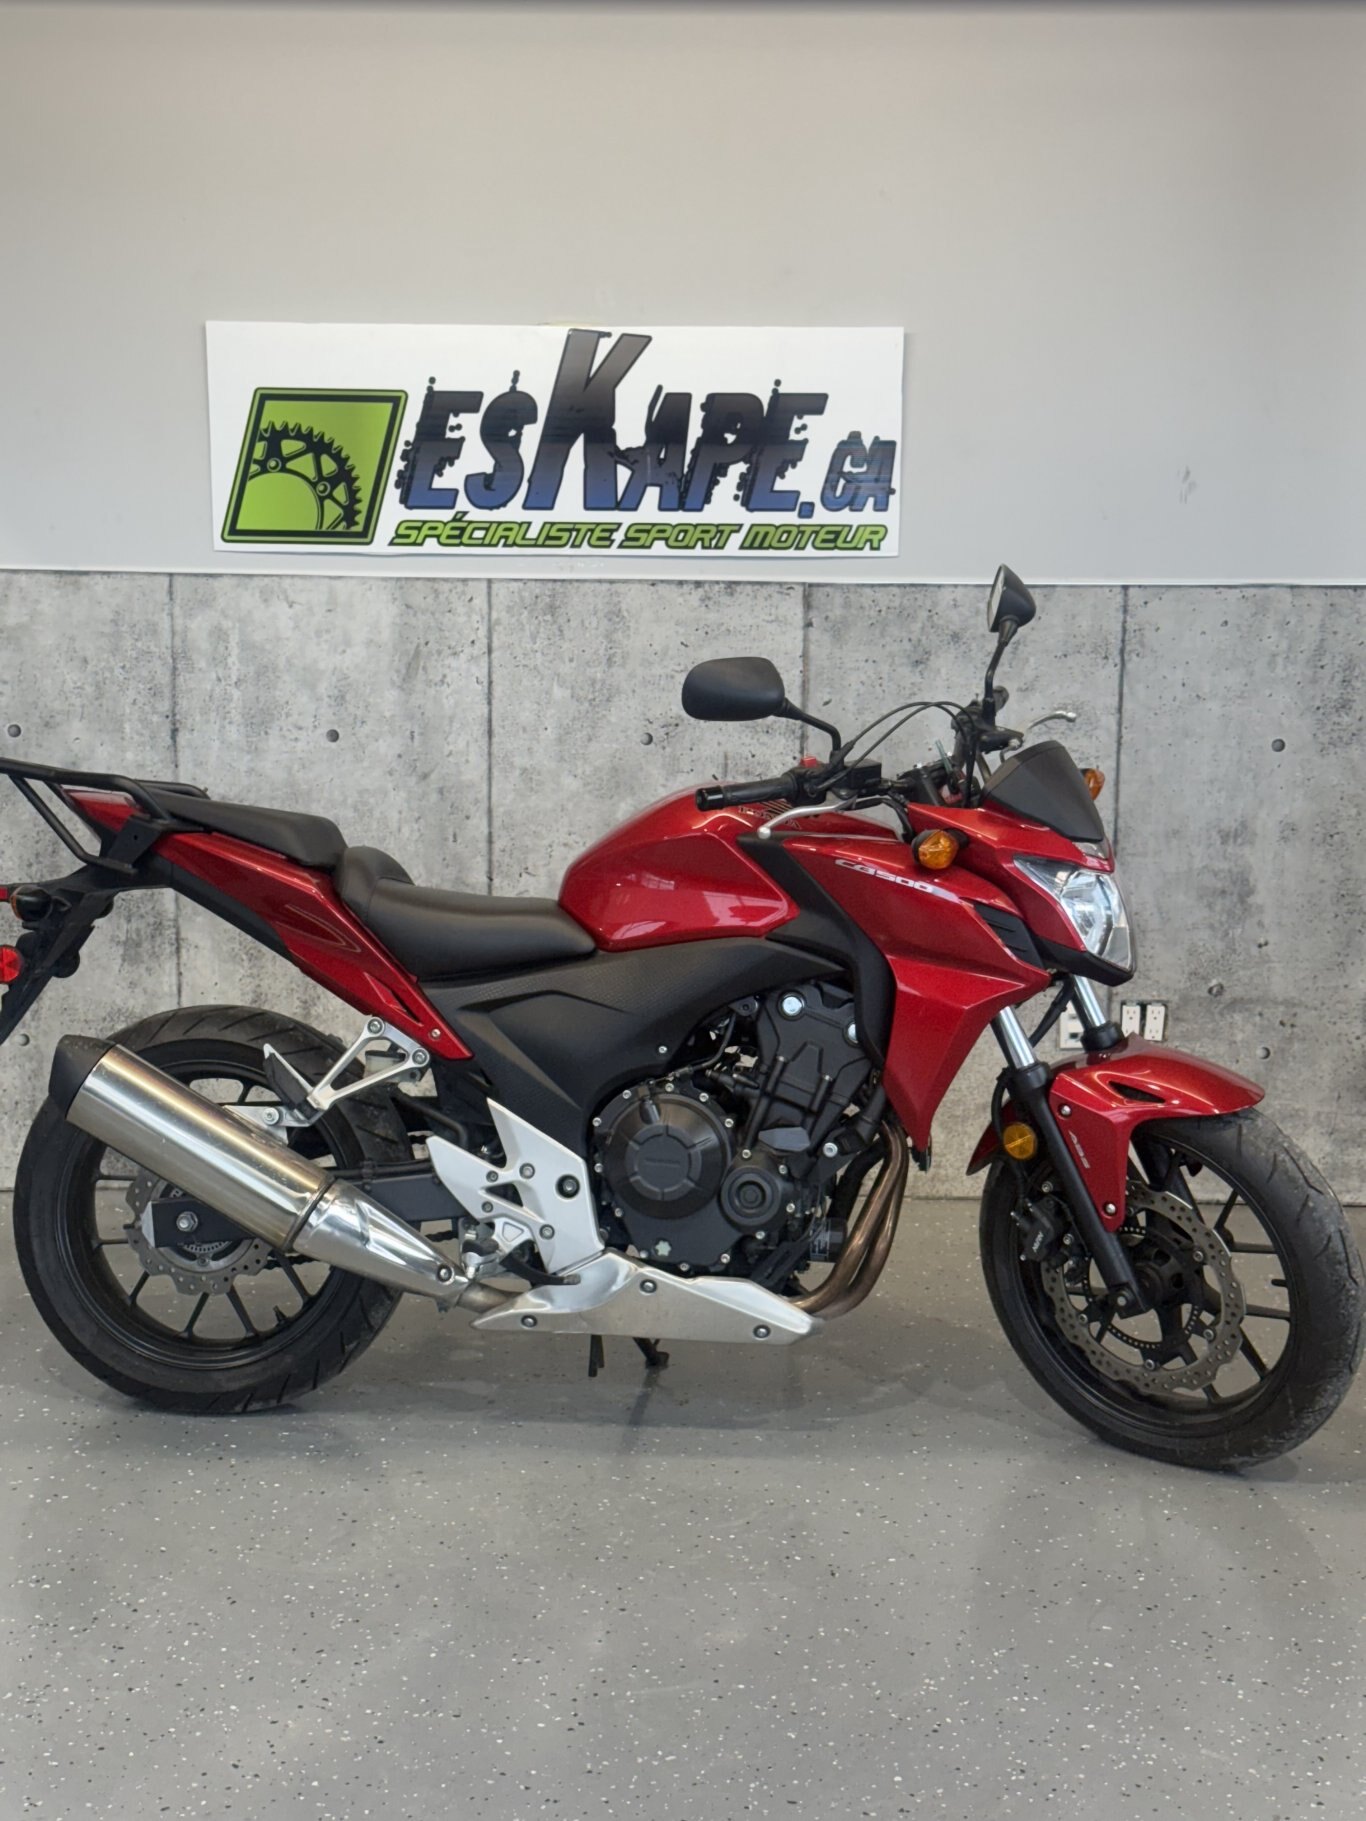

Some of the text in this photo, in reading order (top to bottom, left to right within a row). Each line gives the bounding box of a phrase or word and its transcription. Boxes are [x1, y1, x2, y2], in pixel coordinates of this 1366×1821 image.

[388, 511, 889, 550] SPÉCIALISTE SPORT MOTEUR
